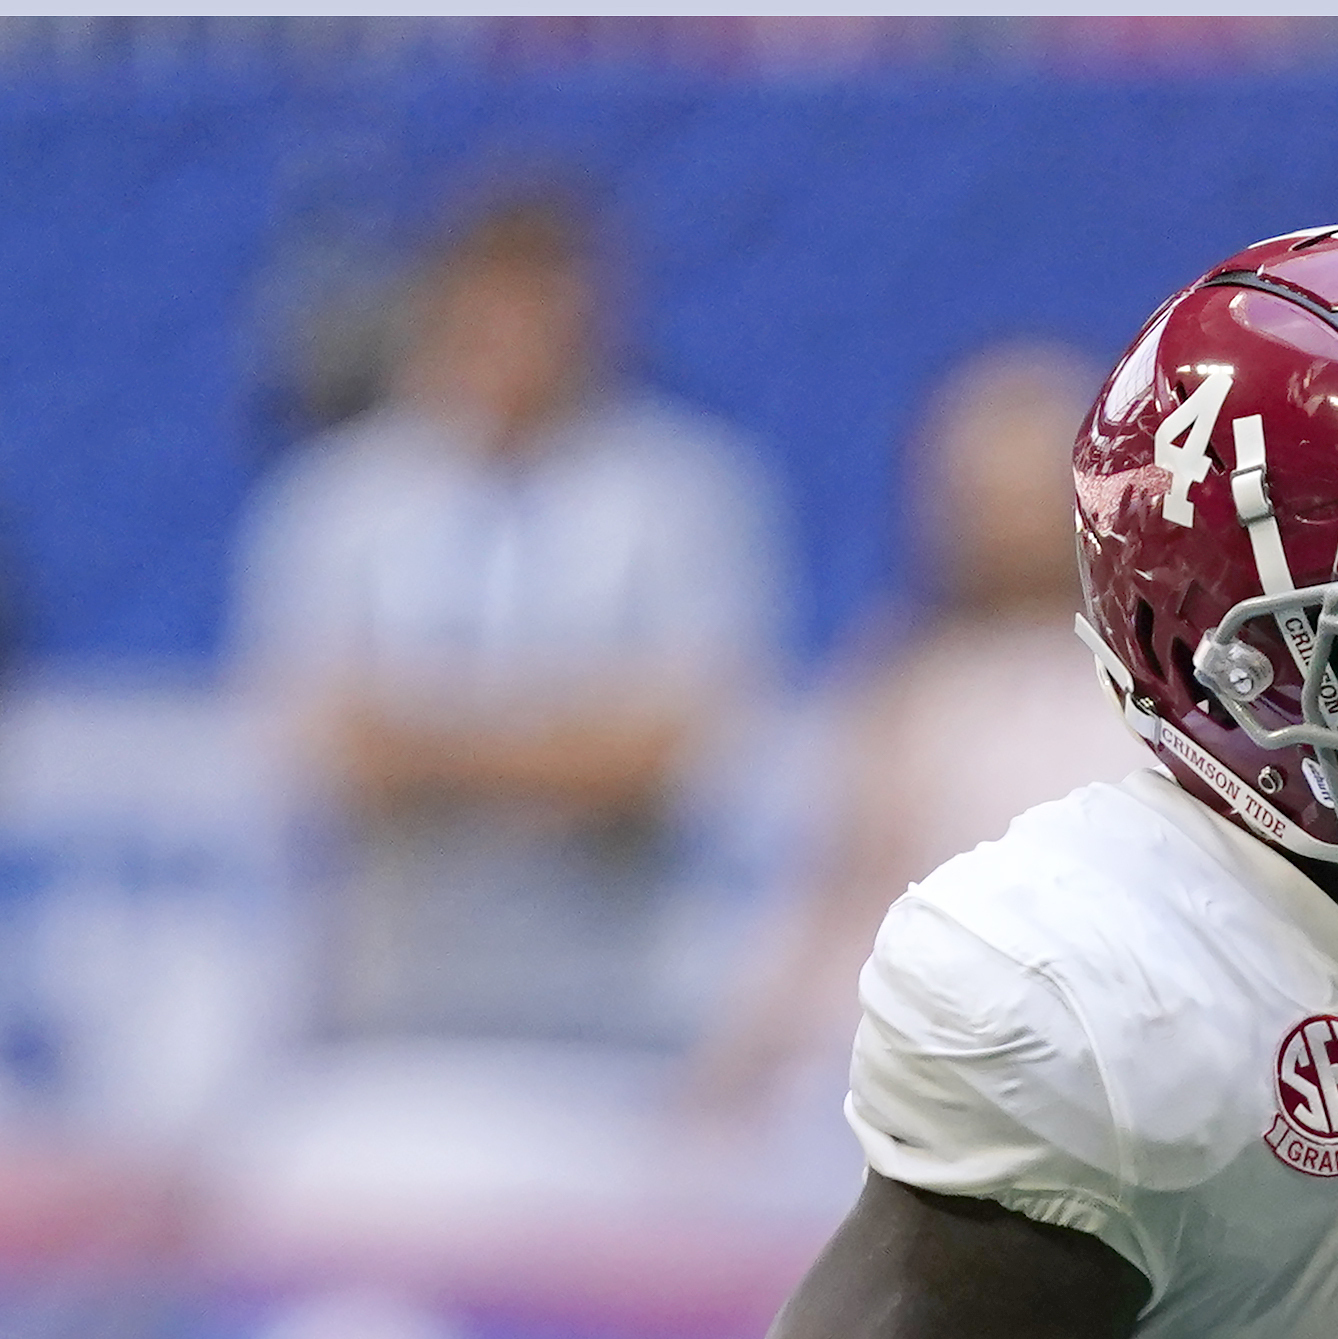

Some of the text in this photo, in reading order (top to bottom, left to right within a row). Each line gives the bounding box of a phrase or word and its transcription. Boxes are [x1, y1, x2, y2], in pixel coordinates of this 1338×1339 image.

[1154, 370, 1234, 528] 4
[1162, 728, 1286, 838] CRIMSON TIDE
